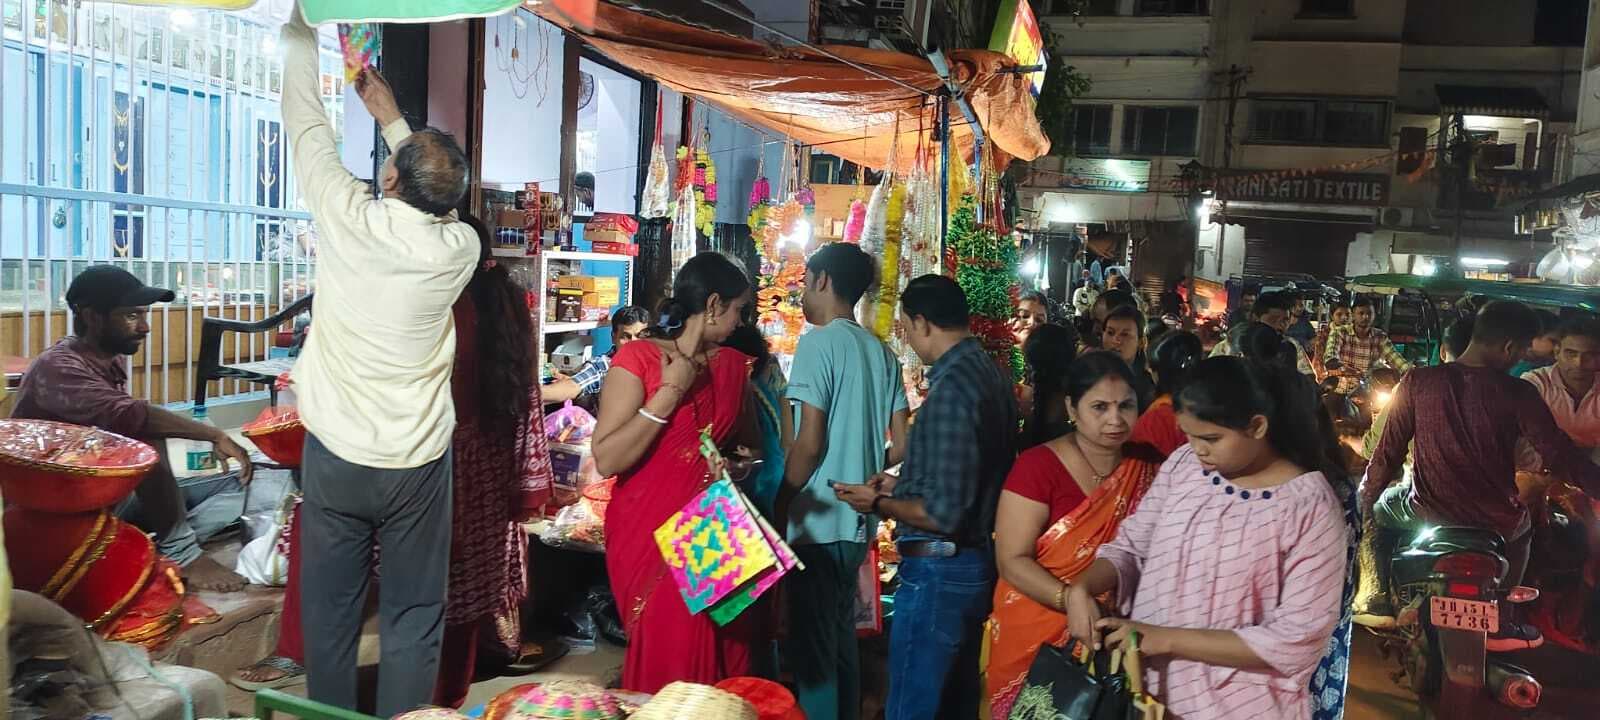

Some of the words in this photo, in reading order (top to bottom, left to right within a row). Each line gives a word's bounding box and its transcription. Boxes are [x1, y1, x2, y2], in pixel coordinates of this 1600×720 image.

[1269, 176, 1308, 199] SATI
[1313, 178, 1382, 200] TEXTILE
[1440, 613, 1490, 630] 7736
